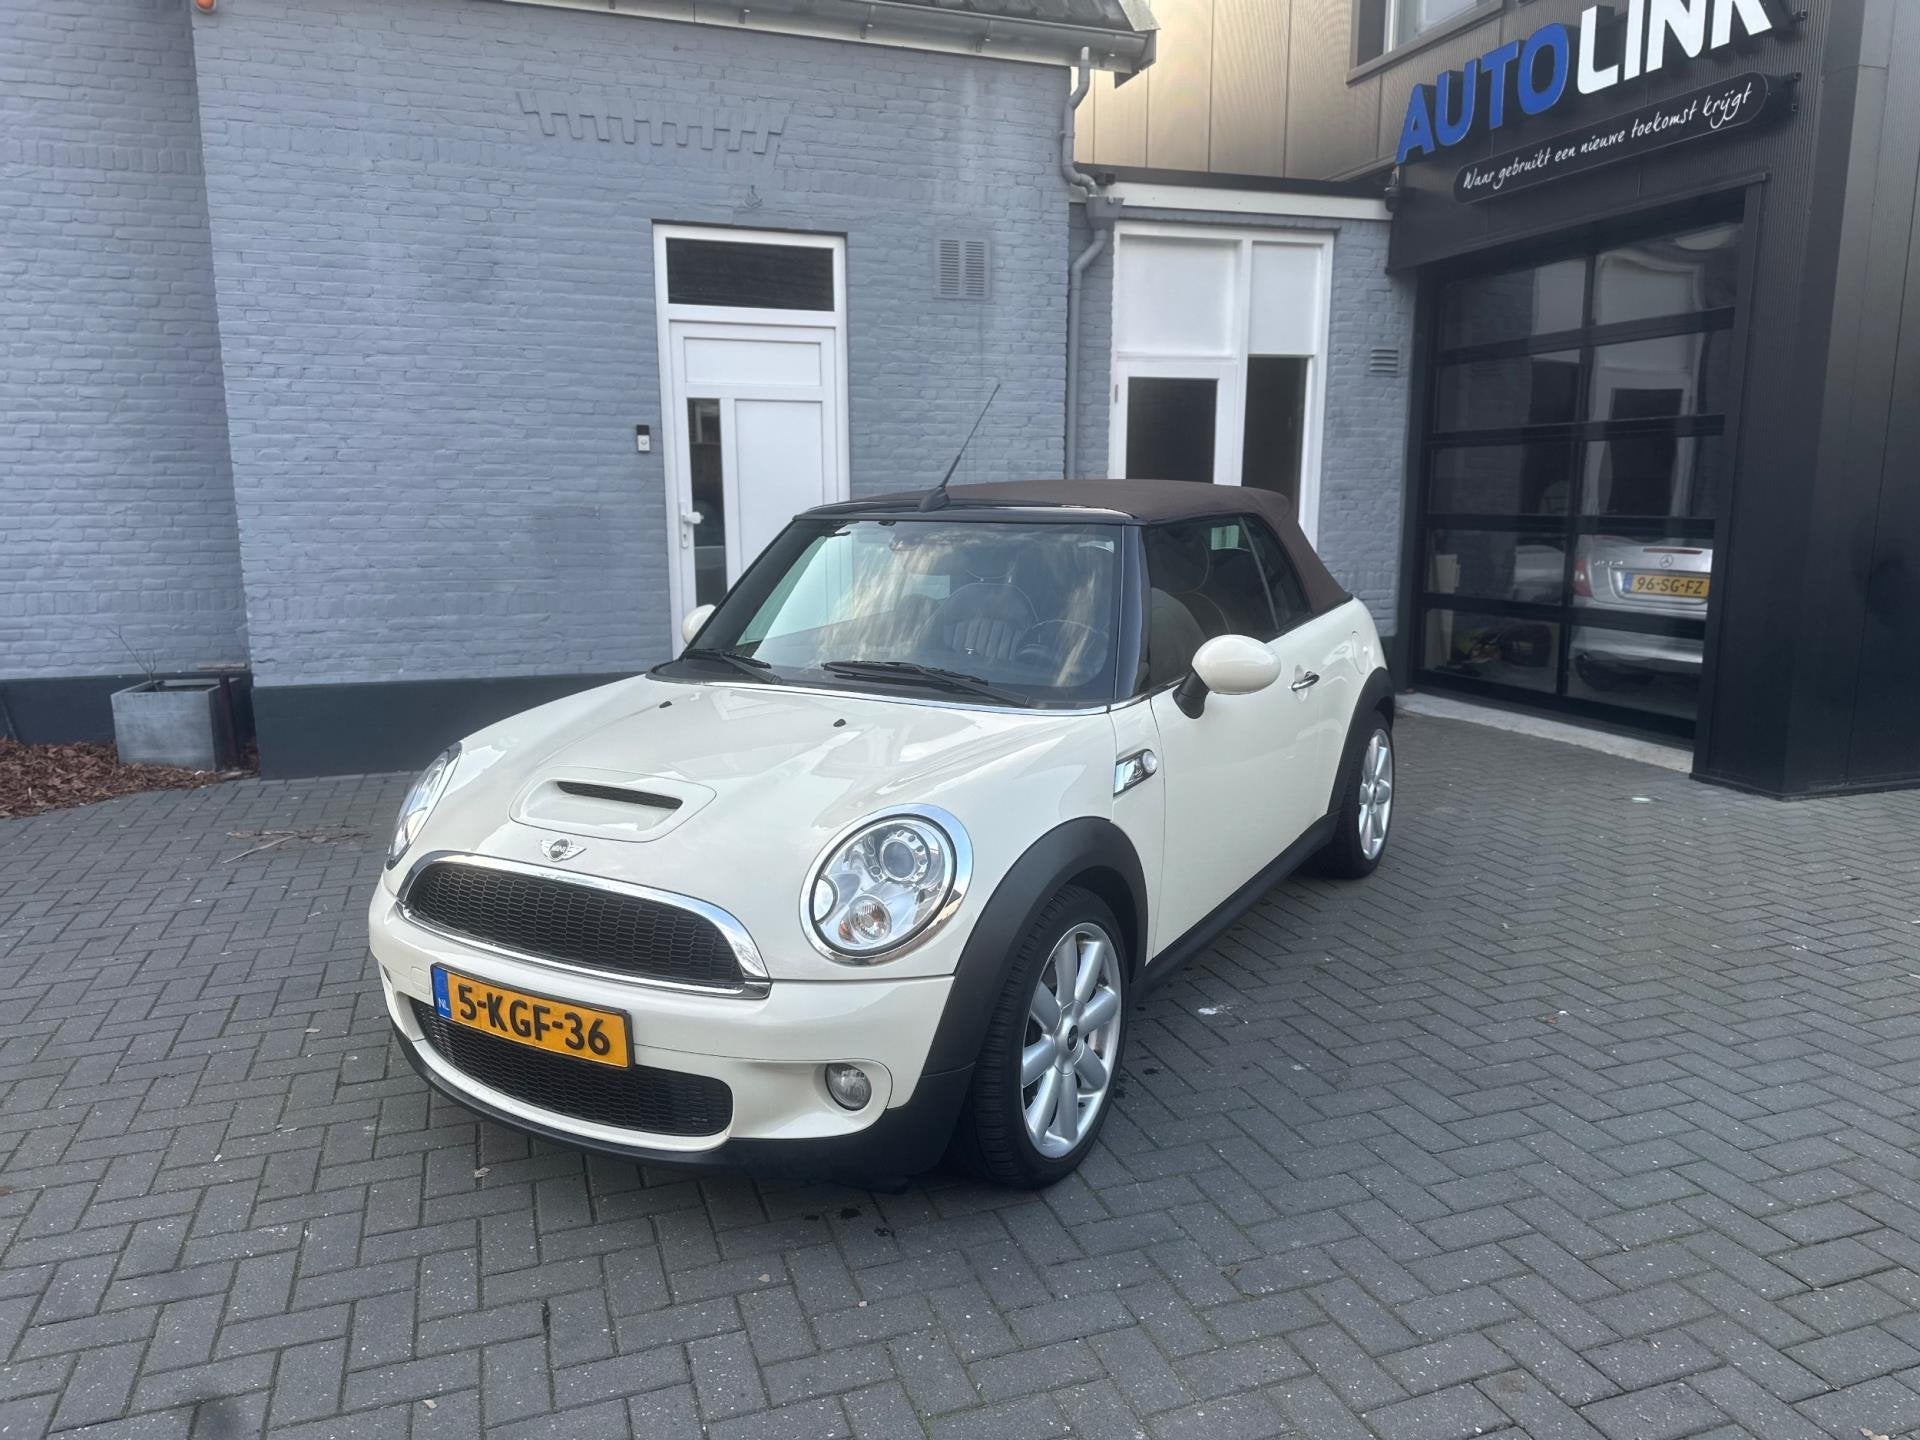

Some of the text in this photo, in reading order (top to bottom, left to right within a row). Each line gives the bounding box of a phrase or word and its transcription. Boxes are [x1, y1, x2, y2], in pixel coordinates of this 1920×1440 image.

[1463, 82, 1753, 190] Waar gebruikt een nieuwe toekomst krijgt
[1637, 576, 1705, 595] 96-SG-FZ
[457, 983, 611, 1056] 5-KGF-36
